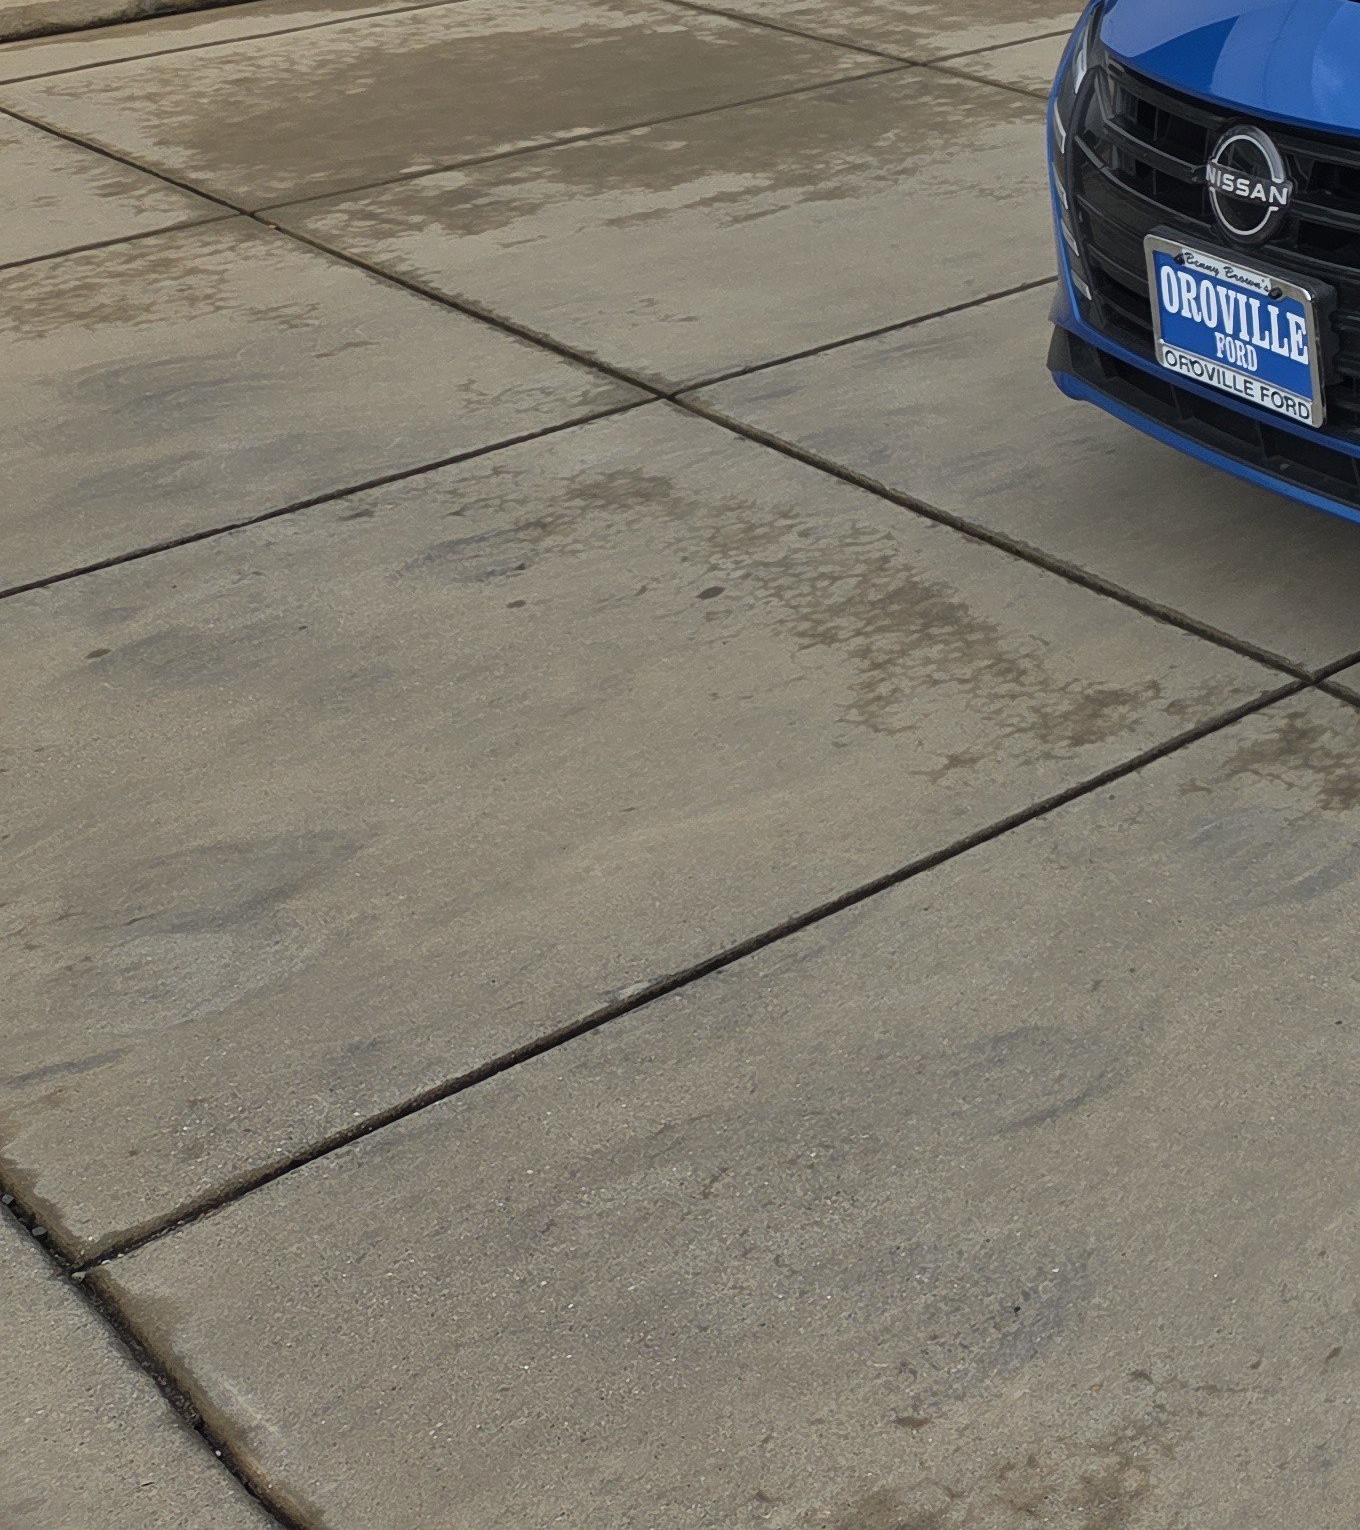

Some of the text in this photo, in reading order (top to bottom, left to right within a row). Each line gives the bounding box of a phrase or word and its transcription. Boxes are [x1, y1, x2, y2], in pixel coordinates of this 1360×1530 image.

[1205, 163, 1288, 206] NISSAN
[1184, 251, 1269, 292] Benny Brown's
[1160, 265, 1309, 365] OROVILLE
[1214, 331, 1258, 372] FORD
[1164, 349, 1310, 420] OROVILLE FORD
